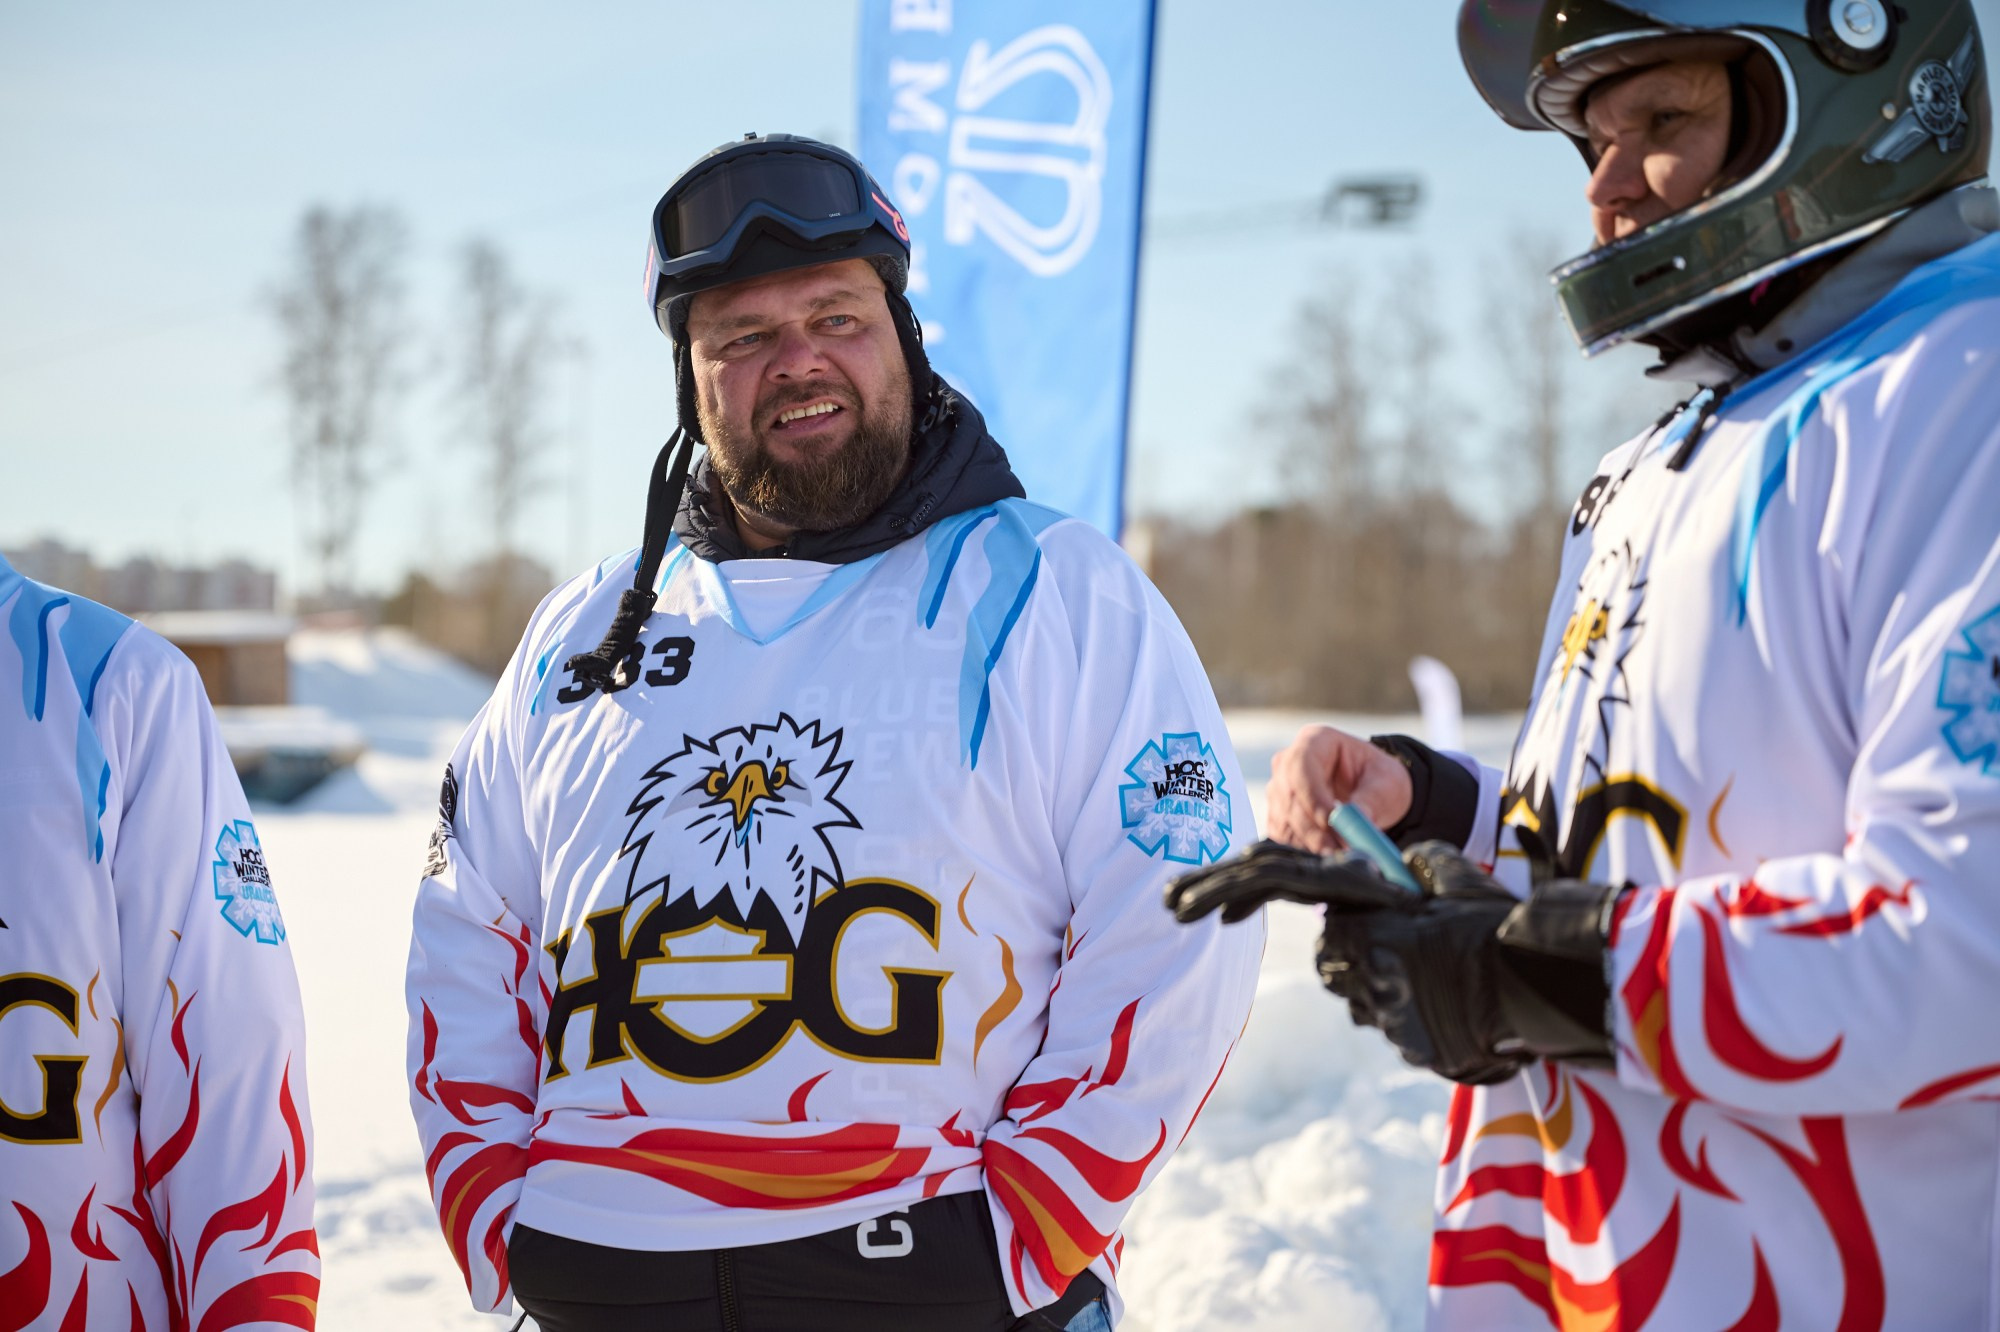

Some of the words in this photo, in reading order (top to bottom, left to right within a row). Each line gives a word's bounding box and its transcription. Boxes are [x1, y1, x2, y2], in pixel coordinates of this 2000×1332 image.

[1916, 65, 1945, 104] HARLEY
[1152, 776, 1214, 800] WINTER
[1154, 798, 1191, 816] URAL
[233, 861, 271, 884] WINTER
[544, 876, 954, 1085] HOG
